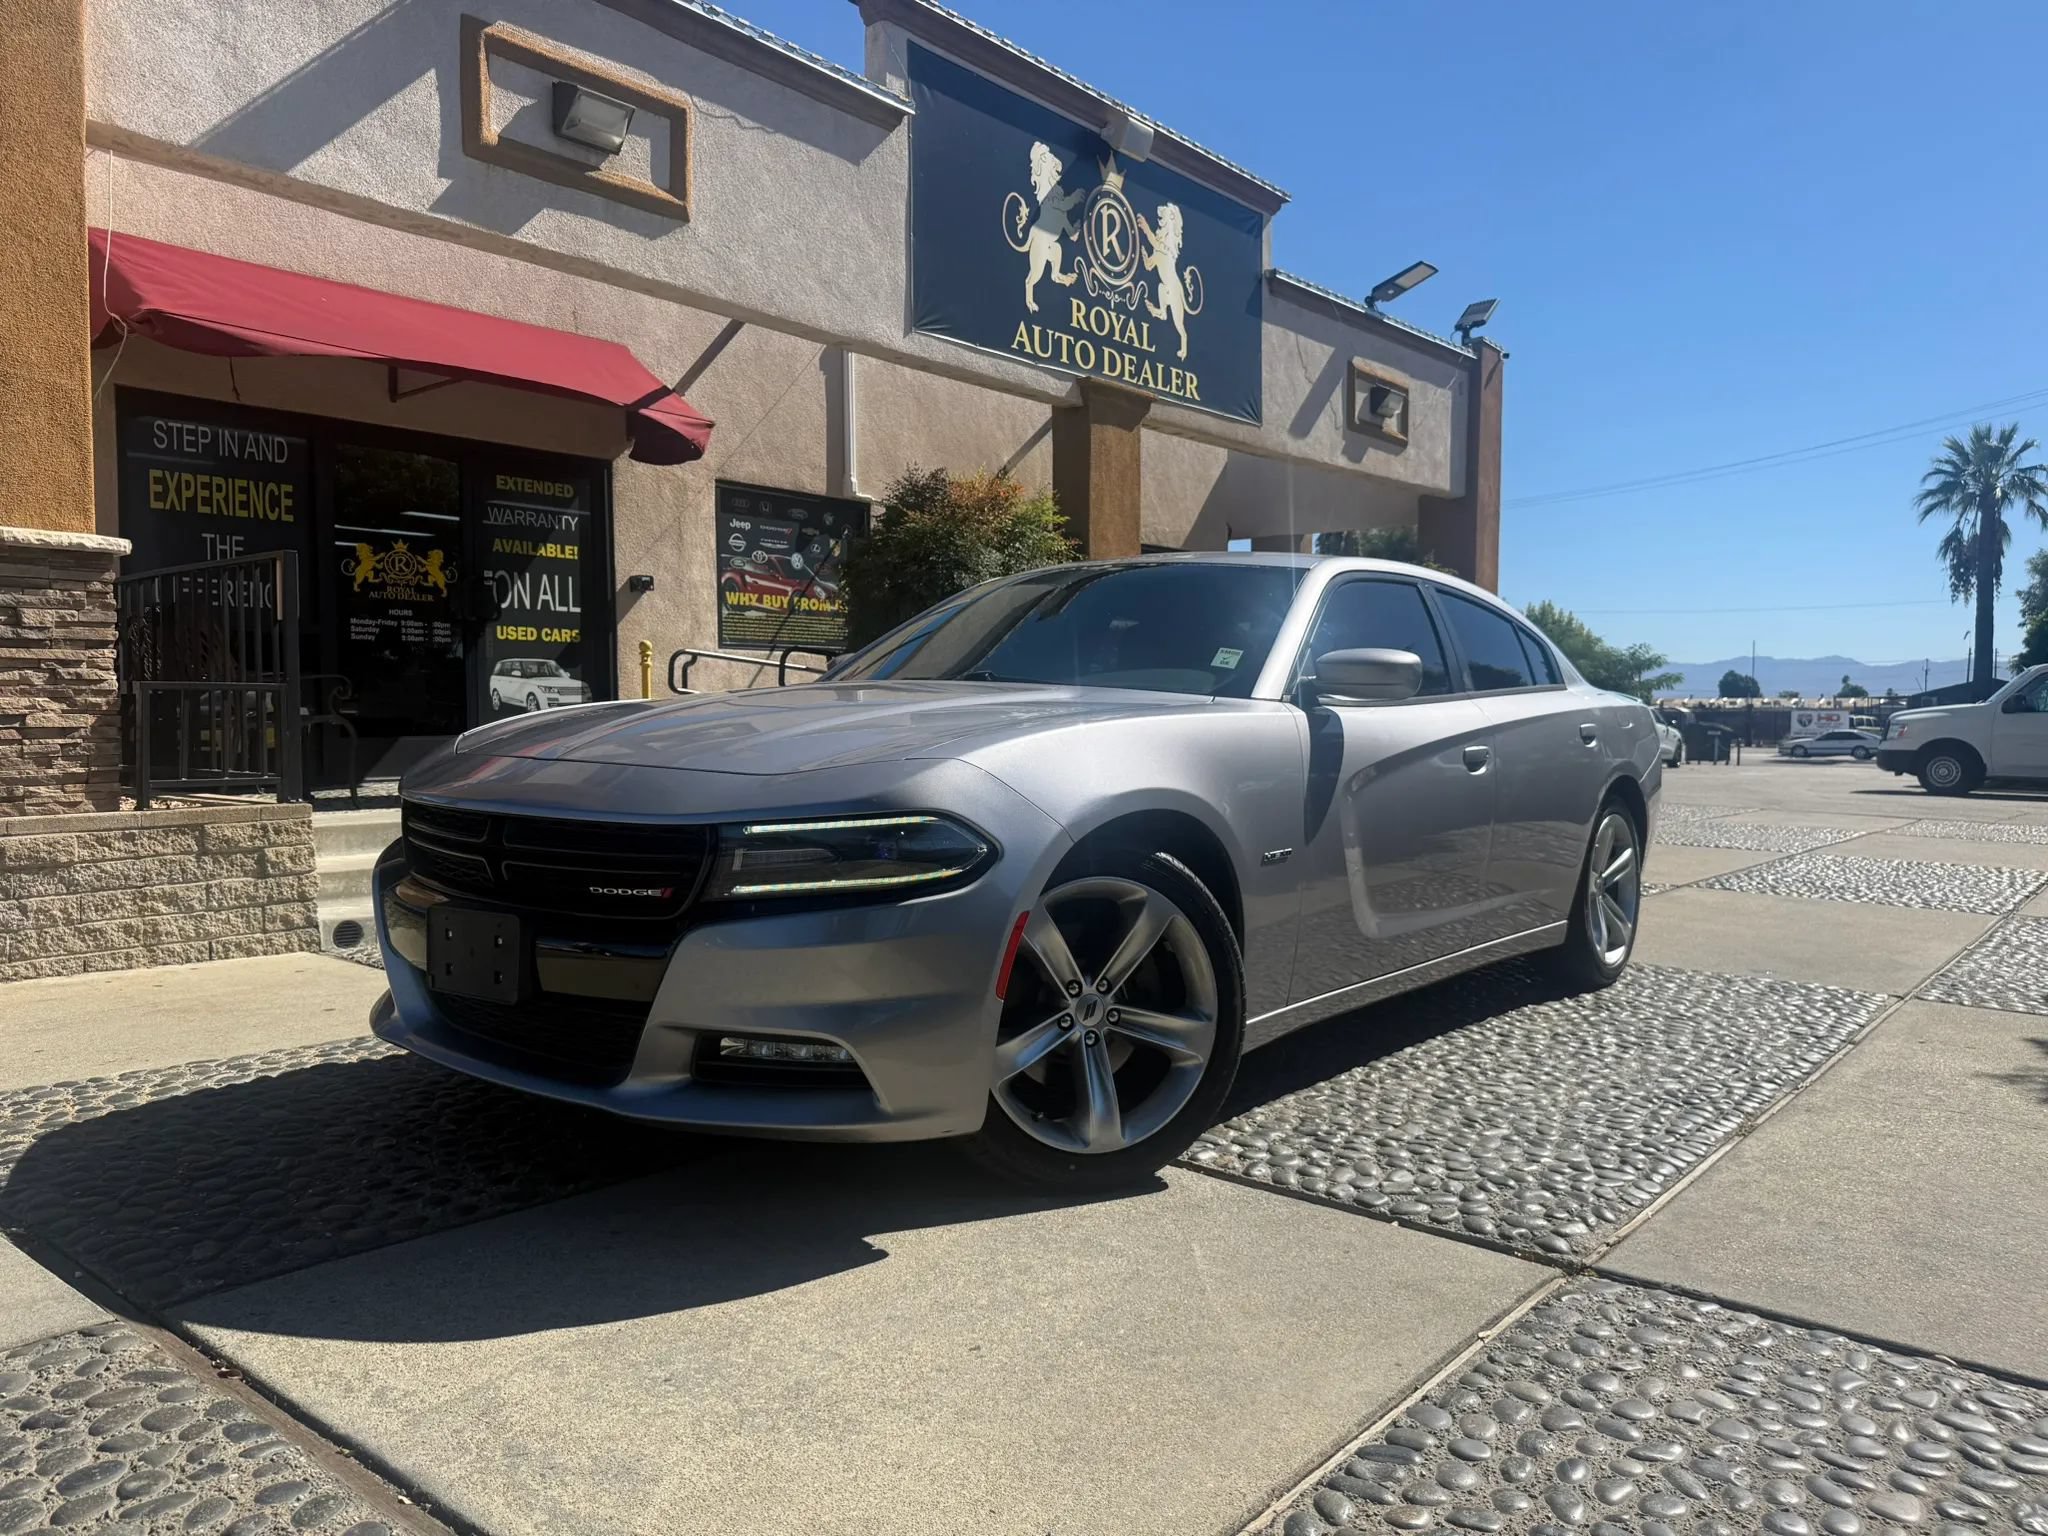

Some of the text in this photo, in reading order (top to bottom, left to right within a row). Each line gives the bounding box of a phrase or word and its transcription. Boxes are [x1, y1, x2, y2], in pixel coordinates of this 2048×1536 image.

[1100, 204, 1126, 262] R
[1070, 297, 1156, 352] ROYAL
[1011, 320, 1201, 401] AUTO DEALER
[153, 420, 288, 464] STEP IN AND
[149, 469, 295, 522] EXPERIENCE
[496, 475, 575, 498] EXTENDED
[488, 506, 579, 531] WARRANTY
[729, 518, 752, 530] Jeep
[201, 533, 245, 560] THE
[492, 538, 579, 560] AVAILABLE!
[395, 556, 409, 572] R
[368, 591, 434, 601] AUTO DEALER
[387, 585, 415, 594] ROYAL
[493, 570, 581, 613] ON ALL
[725, 591, 758, 606] WHY
[762, 594, 790, 609] BUY
[350, 618, 398, 627] Monday-Friday
[350, 625, 380, 634] Saturday
[350, 633, 376, 641] Sunday
[496, 625, 581, 643] USED CARS
[589, 887, 662, 897] DODGE
